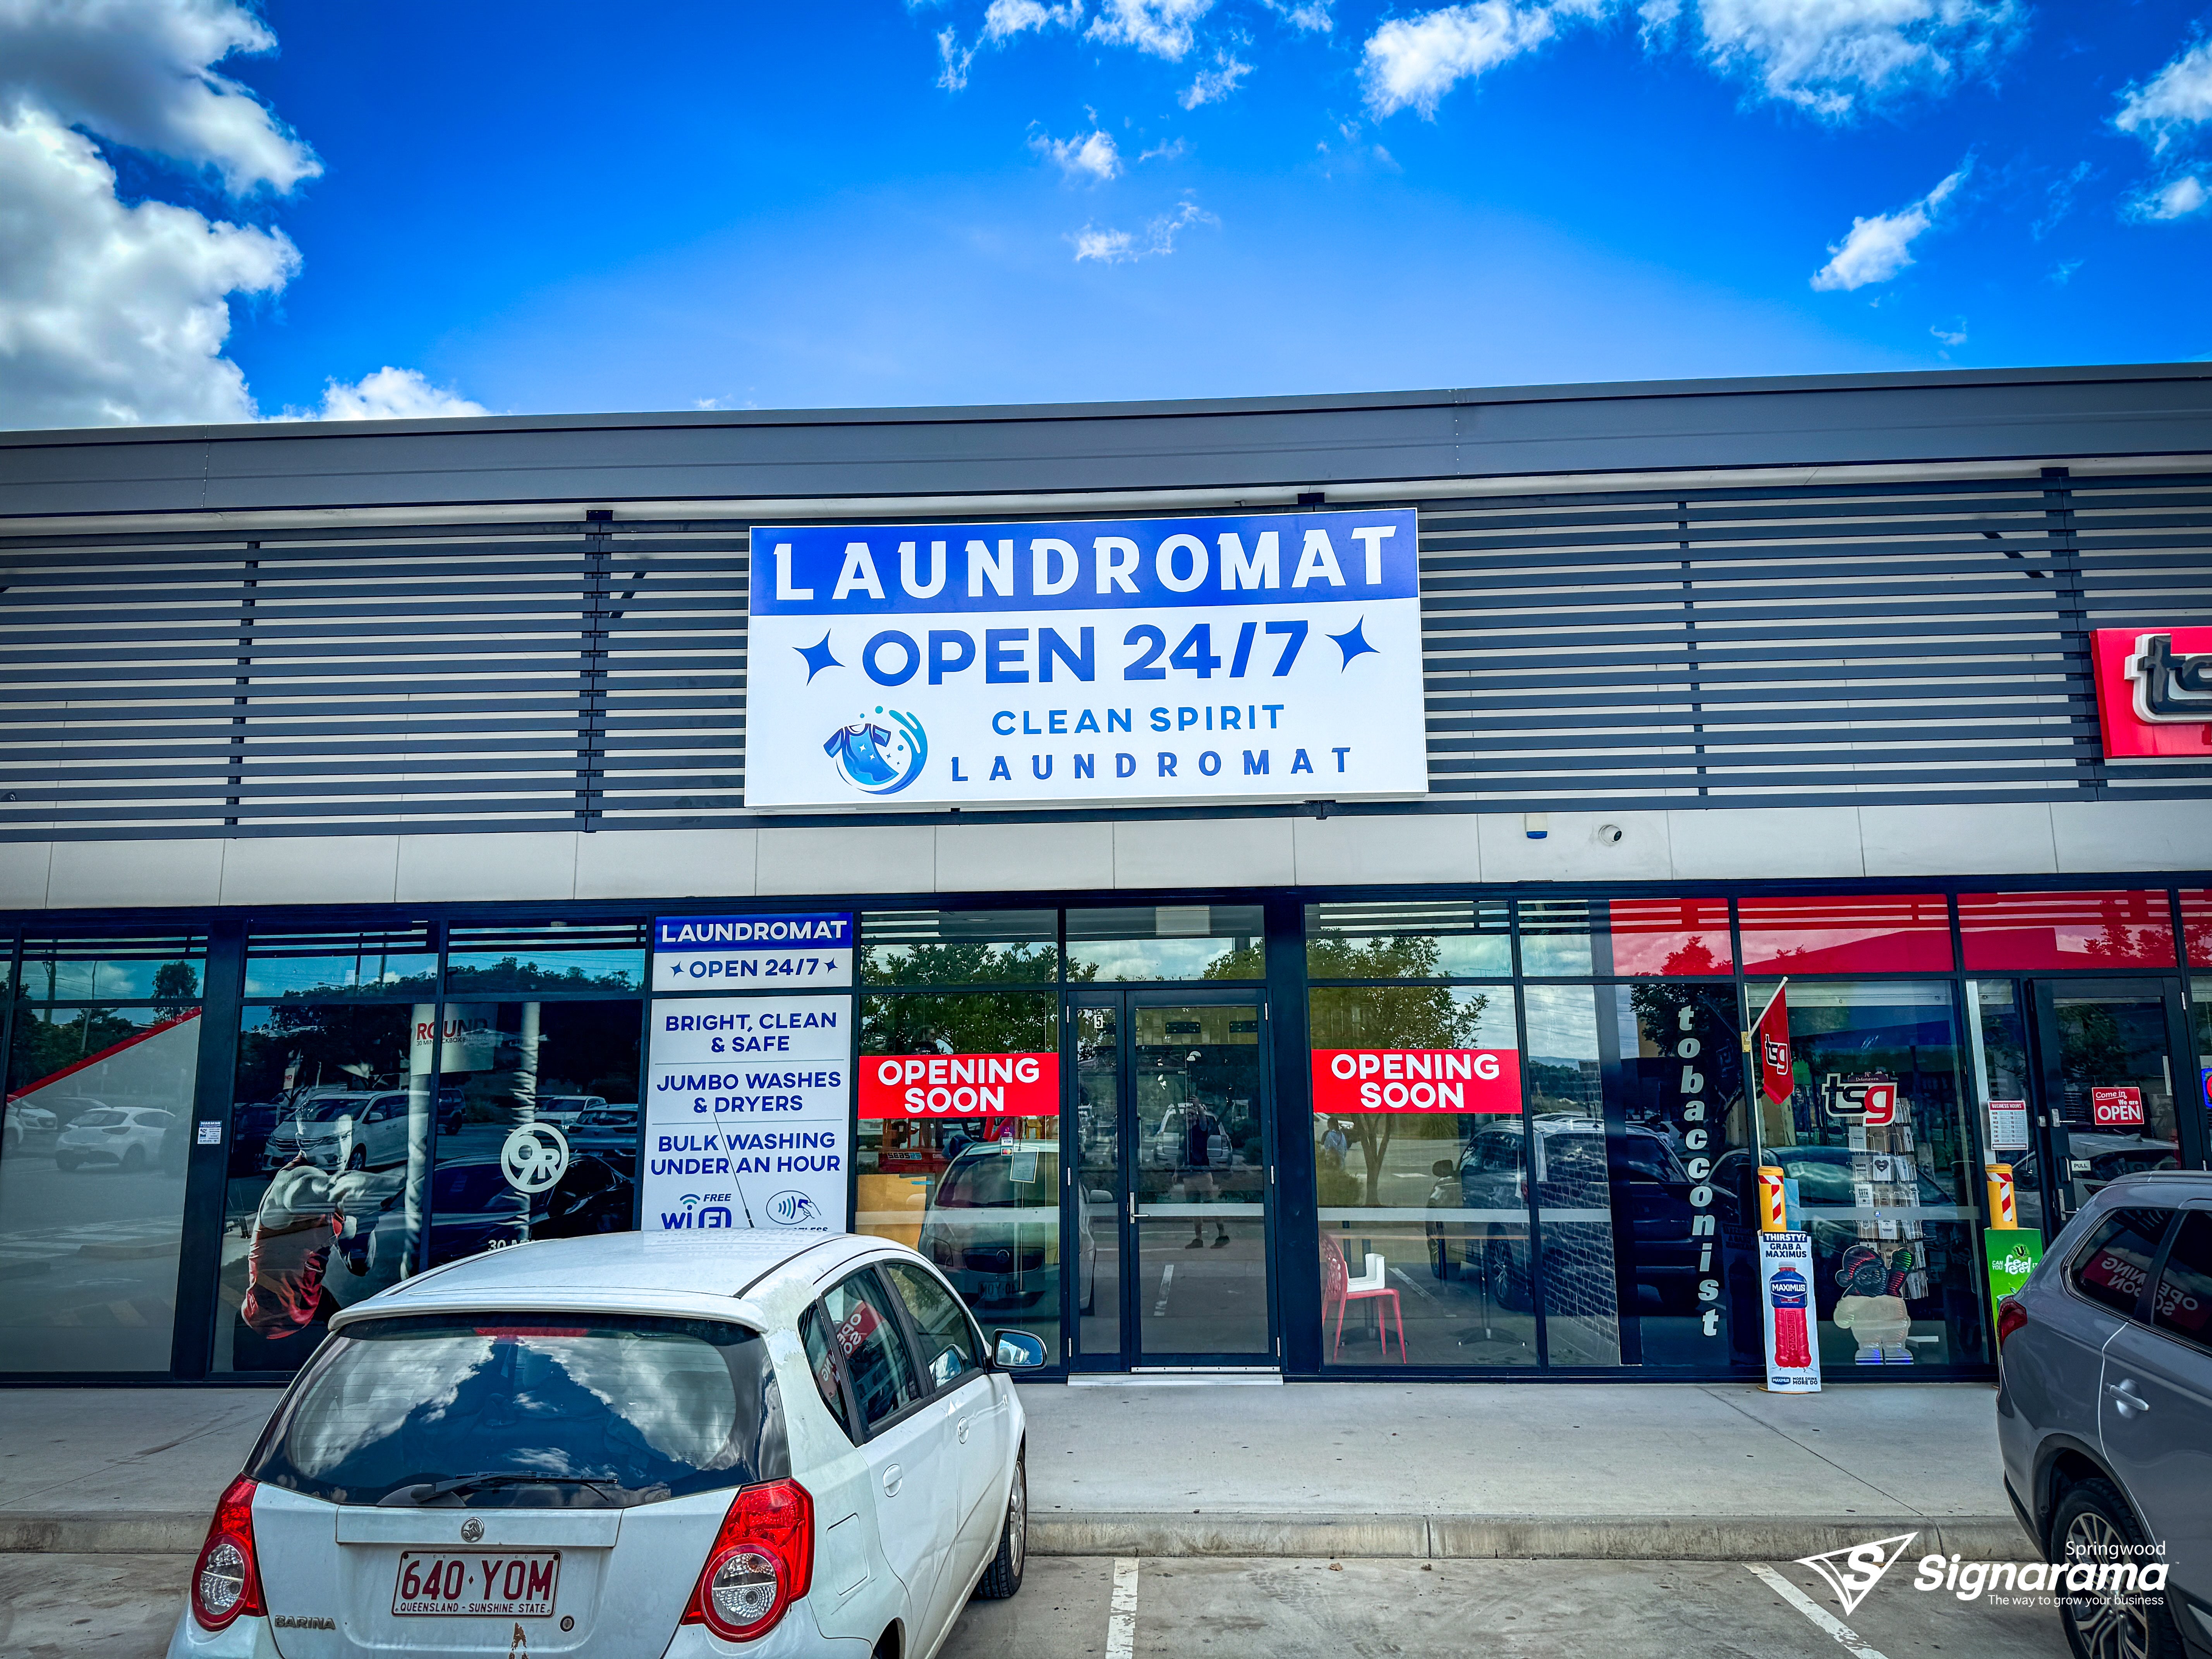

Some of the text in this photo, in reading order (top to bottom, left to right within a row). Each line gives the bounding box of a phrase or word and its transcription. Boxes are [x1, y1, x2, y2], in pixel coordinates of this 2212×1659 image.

[773, 525, 1397, 601] LAUNDROMAT
[862, 620, 1309, 687] OPEN 24/7
[2125, 633, 2212, 723] ts
[992, 704, 1285, 736] CLEAN SPIRIT
[951, 747, 1351, 782] LAUNDROMAT
[662, 921, 847, 943] LAUNDROMAT
[689, 958, 819, 978] OPEN 24/7
[666, 1012, 836, 1032] BRIGHT, CLEAN
[1096, 1015, 1101, 1027] 5
[711, 1036, 790, 1053] & SAFE
[878, 1058, 1040, 1085] OPENING
[1331, 1053, 1500, 1080] OPENING
[656, 1072, 841, 1091] JUMBO WASHES
[694, 1095, 802, 1113] & DRYERS
[904, 1086, 1004, 1113] SOON
[1360, 1082, 1465, 1108] SOON
[1821, 1073, 1898, 1127] tsg
[2097, 1105, 2141, 1120] OPEN
[658, 1132, 835, 1152] BULK WASHING
[651, 1155, 840, 1175] UNDER AN HOUR
[1678, 1005, 1719, 1337] tobacconist
[703, 1194, 732, 1202] FREE
[1764, 1233, 1806, 1242] THIRSTY?
[400, 1602, 459, 1612] QUEENSLAND
[469, 1603, 514, 1613] SUNSHINE
[518, 1603, 546, 1613] STATE
[275, 1615, 336, 1630] BARINA
